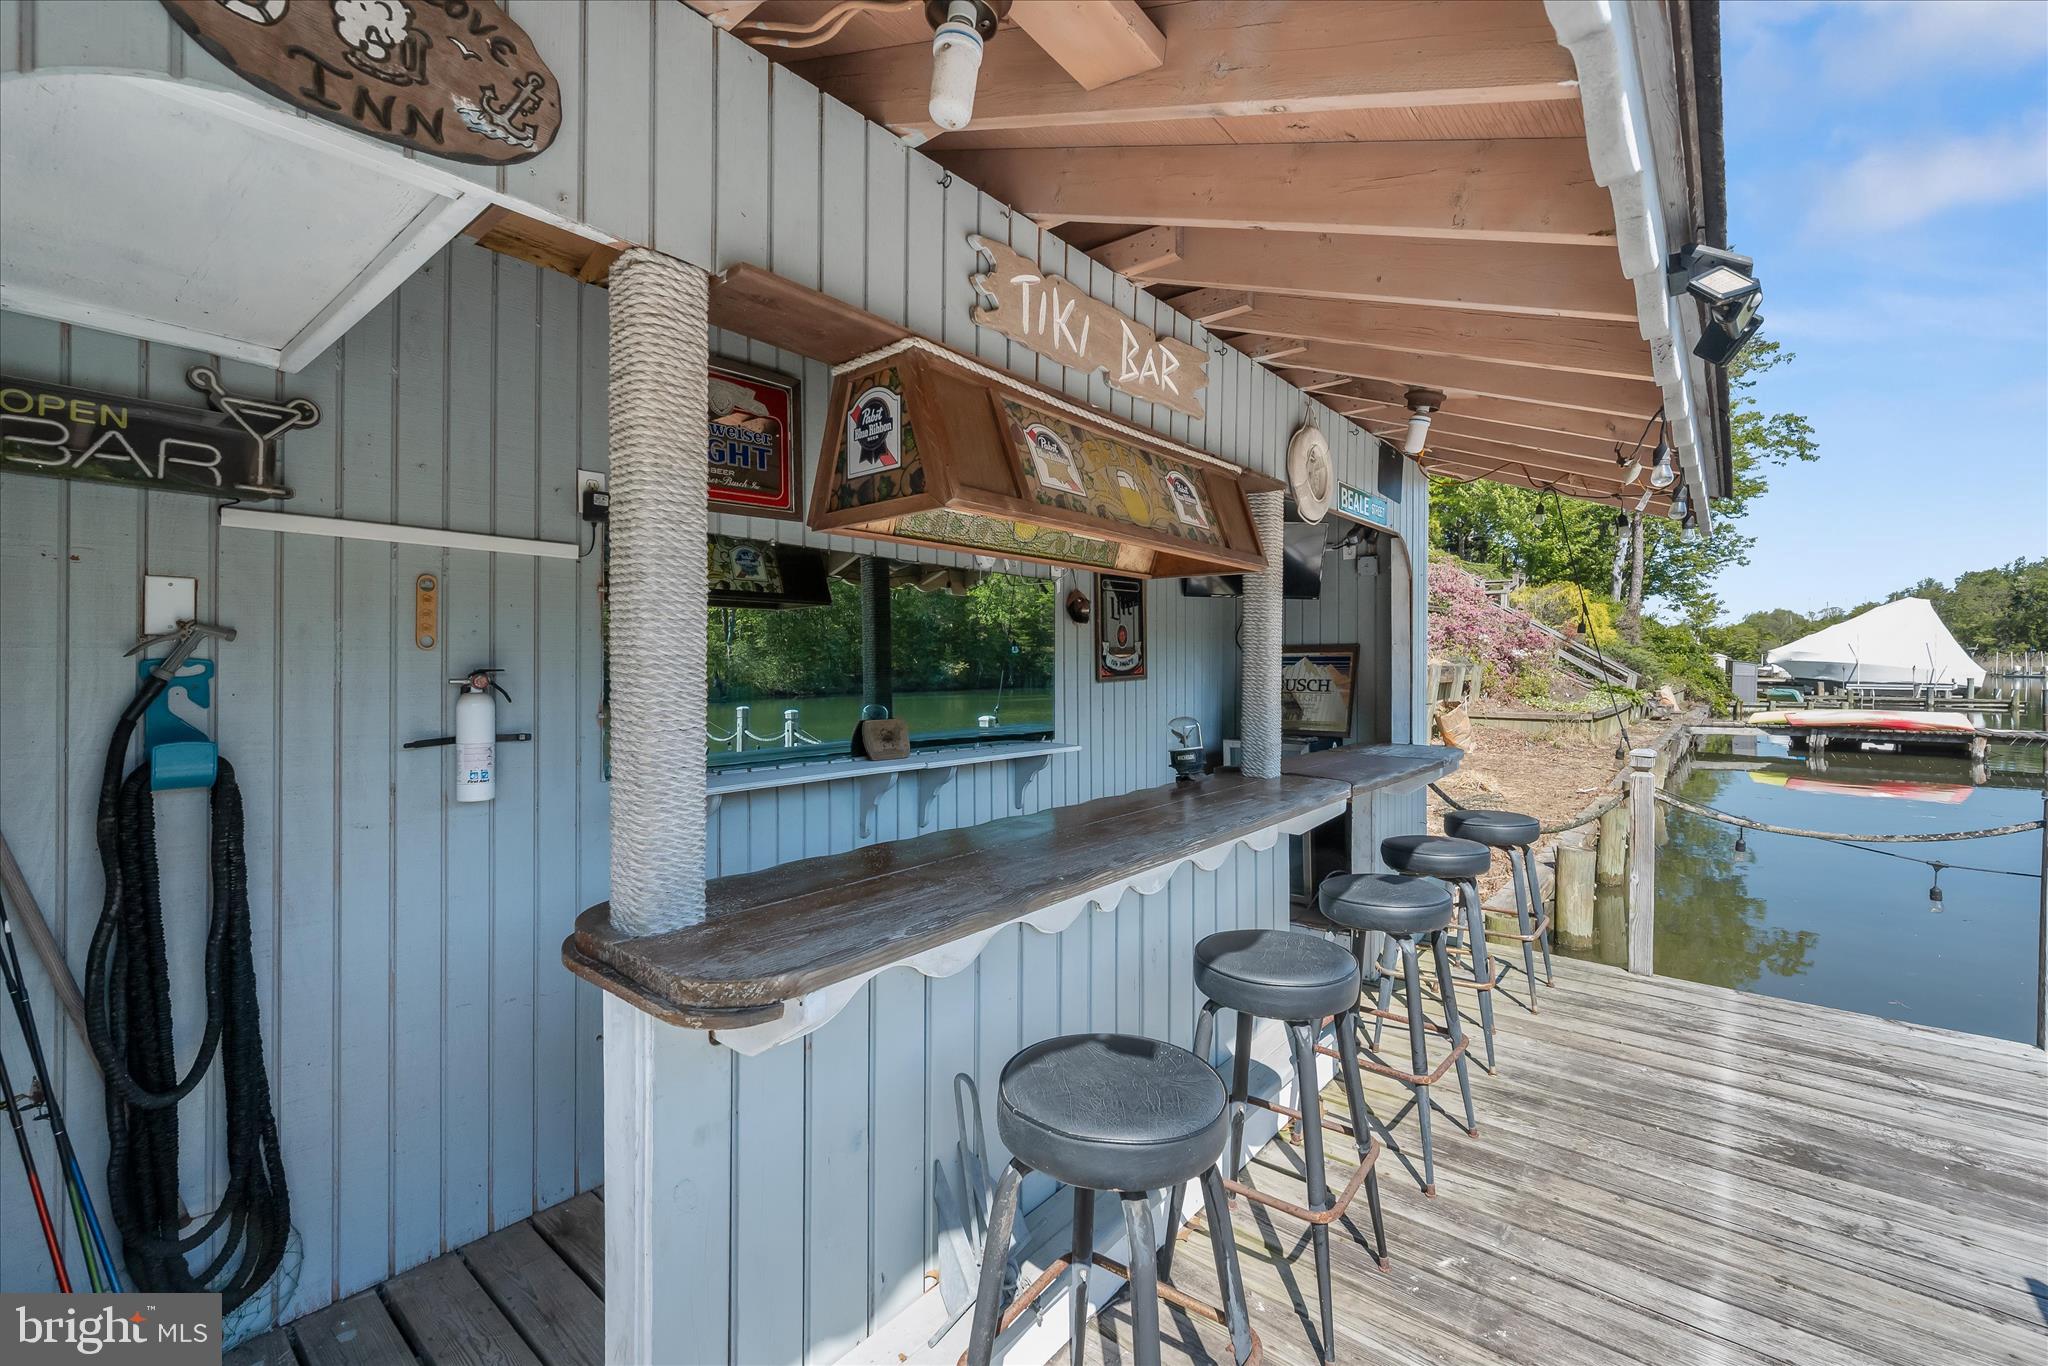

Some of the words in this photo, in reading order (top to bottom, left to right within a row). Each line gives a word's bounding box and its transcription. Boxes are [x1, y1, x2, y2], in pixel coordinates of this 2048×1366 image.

[422, 0, 517, 67] OVE
[286, 45, 445, 145] INN
[1010, 275, 1090, 358] TIKI
[1119, 318, 1180, 396] BAR
[0, 388, 129, 429] OPEN
[862, 407, 883, 425] Pabst
[0, 413, 222, 487] BAR
[708, 422, 773, 446] weiser
[708, 437, 773, 472] GHT
[1341, 486, 1370, 516] BEALE
